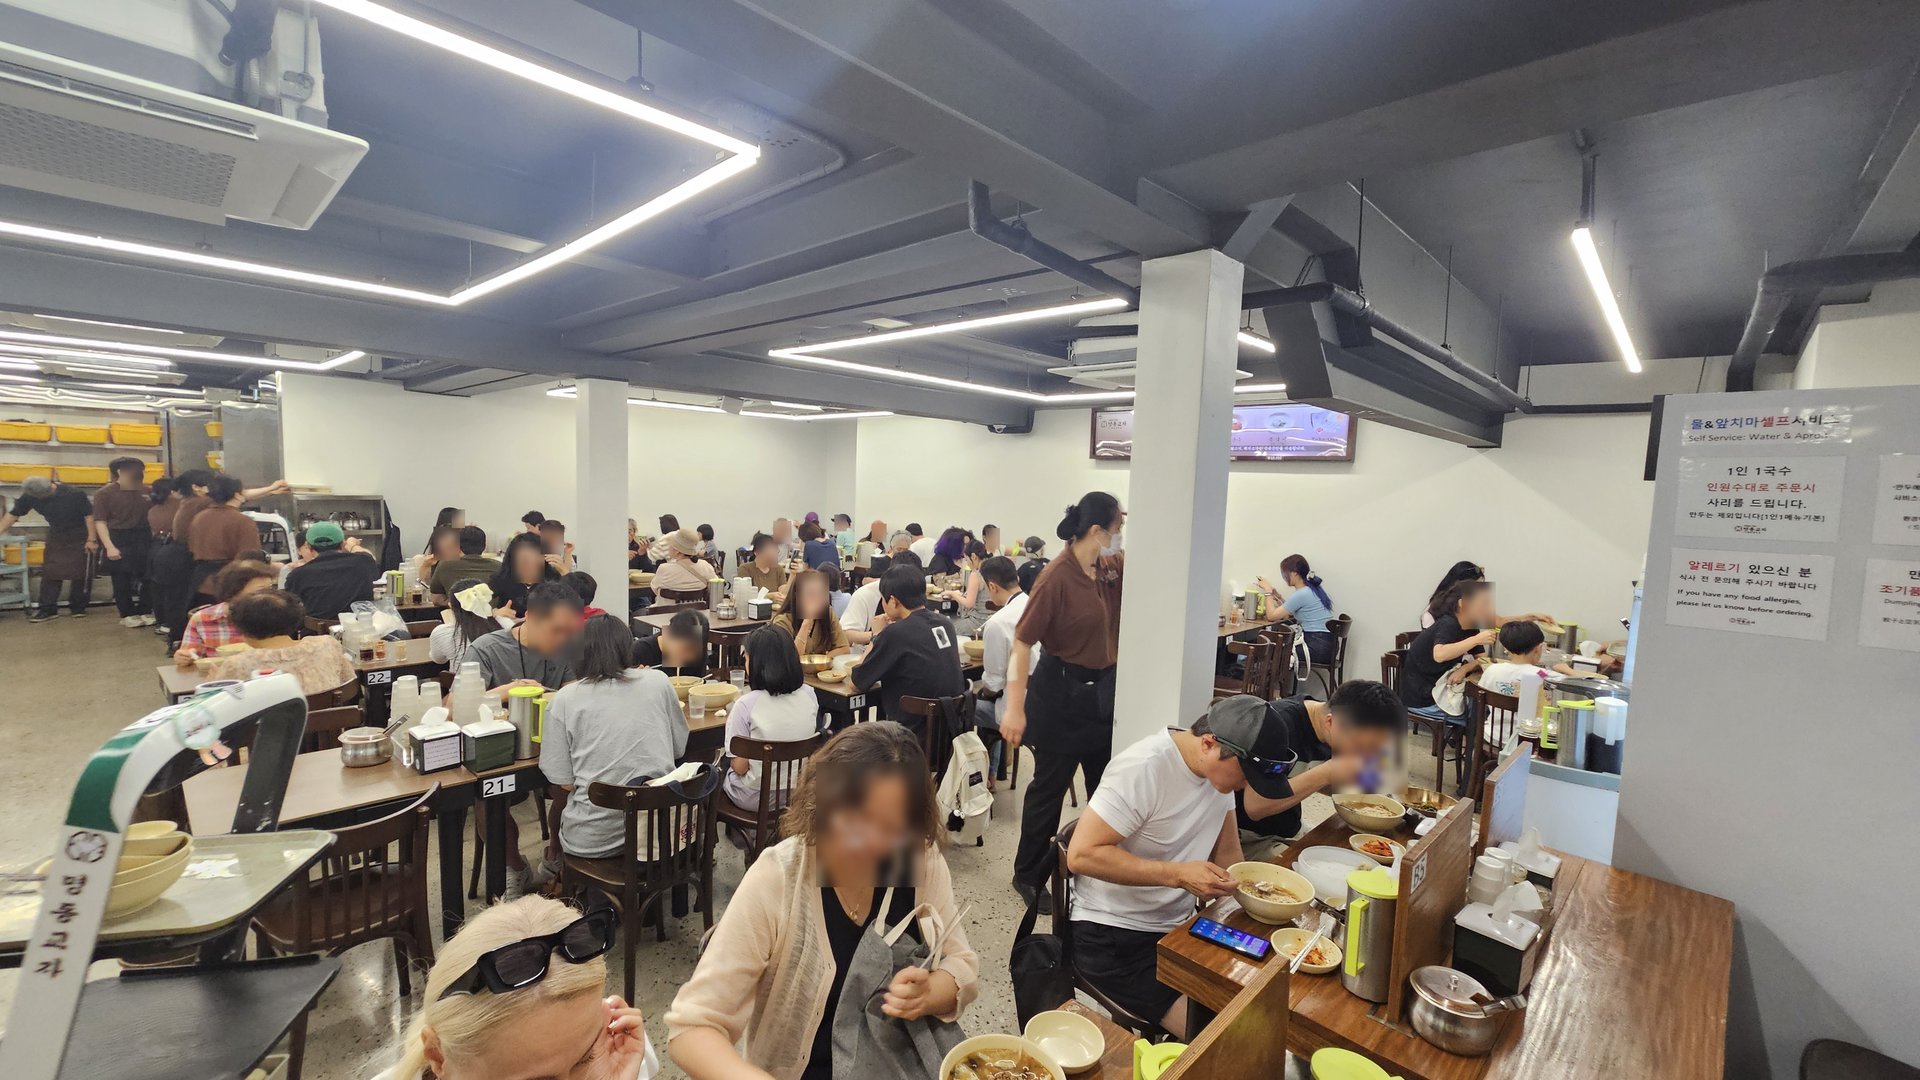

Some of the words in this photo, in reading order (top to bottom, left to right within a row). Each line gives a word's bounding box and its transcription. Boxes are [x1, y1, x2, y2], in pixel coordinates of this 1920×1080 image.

[1749, 433, 1781, 441] Water
[1783, 432, 1792, 440] &
[1727, 466, 1748, 476] 1인
[1755, 466, 1792, 476] 1국수
[1706, 482, 1770, 492] 인원수대로
[1775, 482, 1816, 493] 주문시
[1707, 498, 1744, 508] 사리를
[1749, 499, 1807, 509] 드립니다.
[1688, 560, 1740, 573] 알레르기
[1748, 564, 1790, 577] 있으신
[1798, 568, 1813, 578] 분
[1700, 575, 1709, 583] 전
[1714, 576, 1740, 584] 문의해
[1745, 579, 1773, 587] 주시기
[1777, 581, 1817, 591] 바랍니다
[1724, 603, 1745, 611] know
[852, 695, 863, 708] 11
[34, 874, 89, 979] 명동교자
